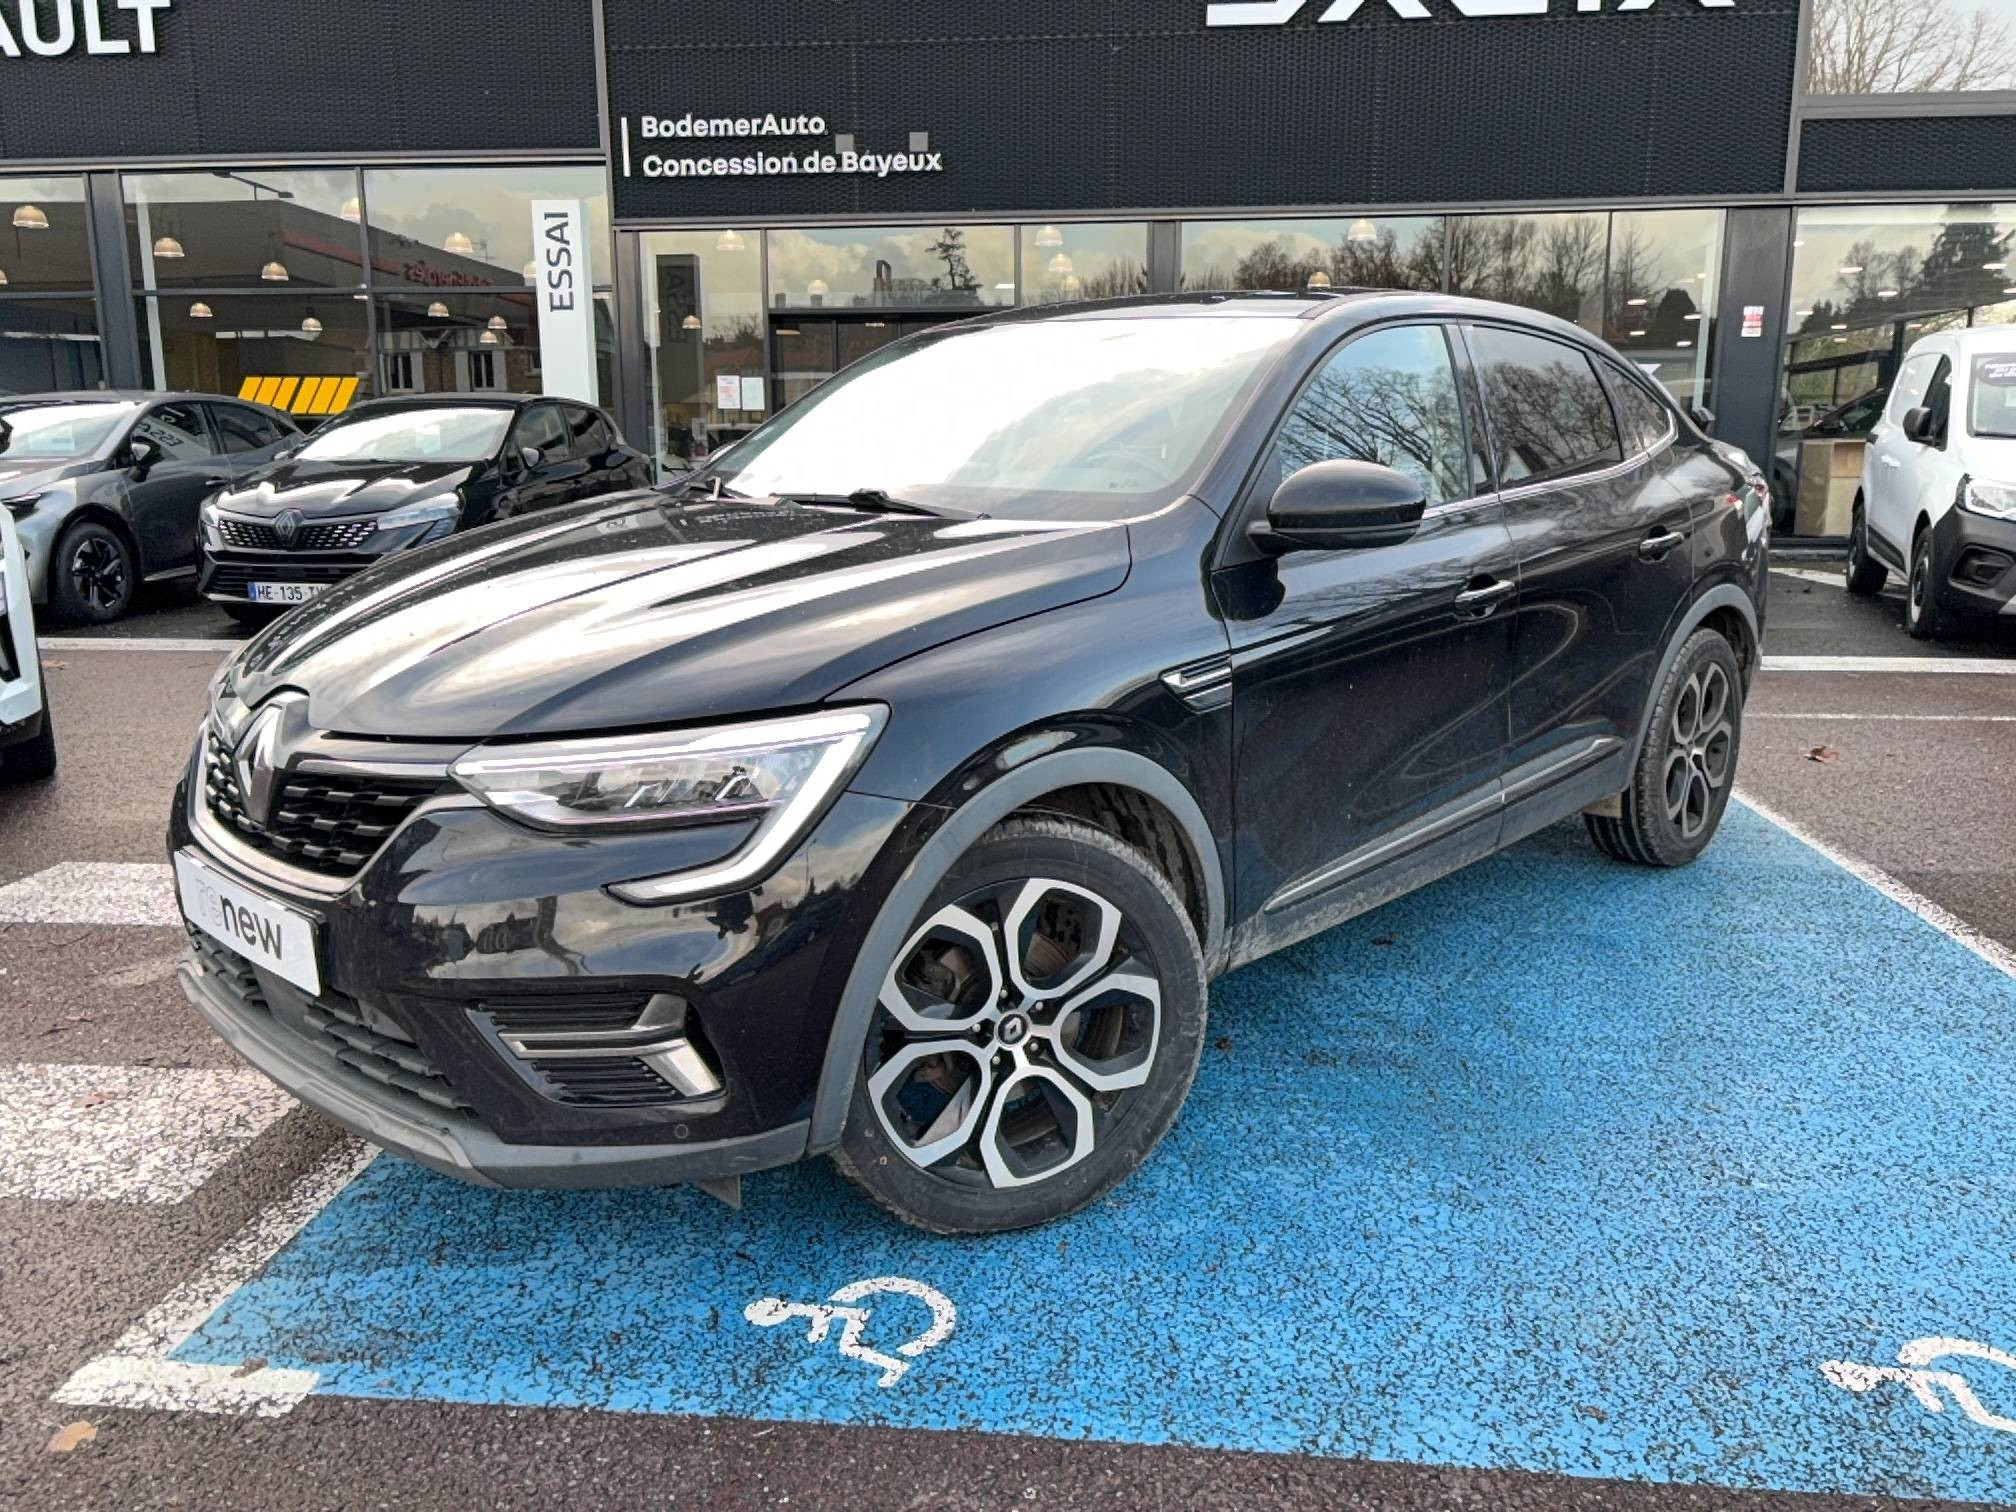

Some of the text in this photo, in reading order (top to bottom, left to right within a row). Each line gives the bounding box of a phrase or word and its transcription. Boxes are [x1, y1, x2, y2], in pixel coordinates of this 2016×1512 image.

[0, 0, 171, 57] ULT
[641, 113, 827, 138] BodemerAuto
[642, 150, 944, 178] Concession de Bayeux
[543, 211, 575, 313] ESSAI
